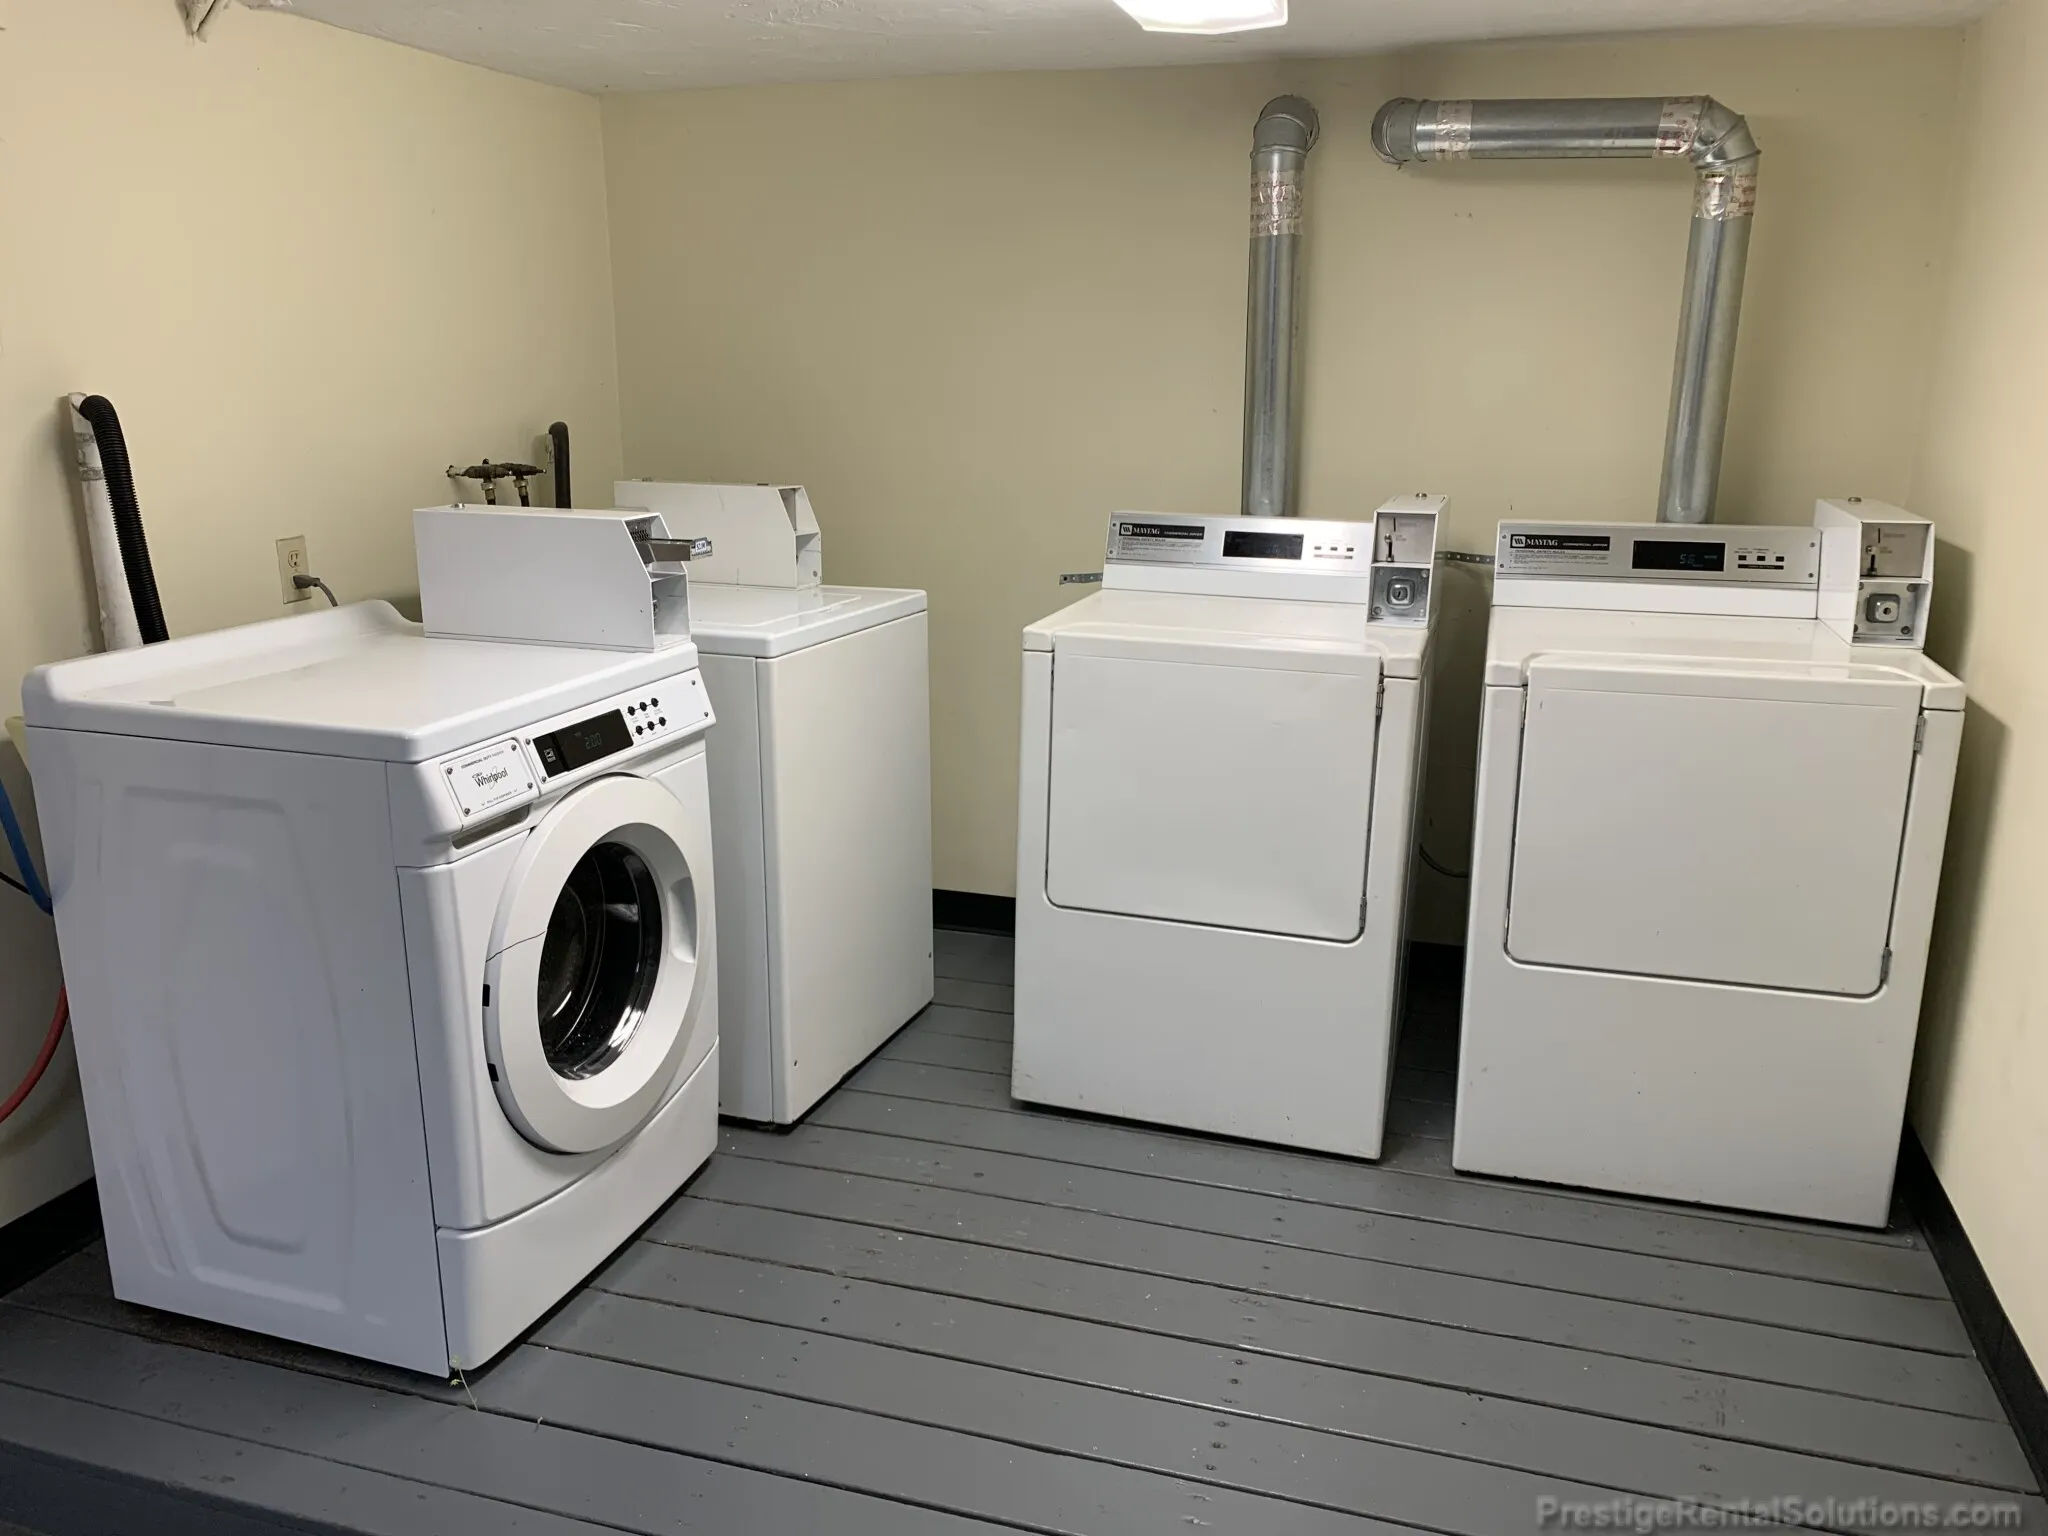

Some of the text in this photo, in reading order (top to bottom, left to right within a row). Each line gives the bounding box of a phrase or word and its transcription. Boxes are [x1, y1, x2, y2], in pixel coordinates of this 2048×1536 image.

[1132, 526, 1160, 535] MAYTAG
[1526, 538, 1558, 546] MAYTAG
[474, 767, 509, 787] Whirlpool
